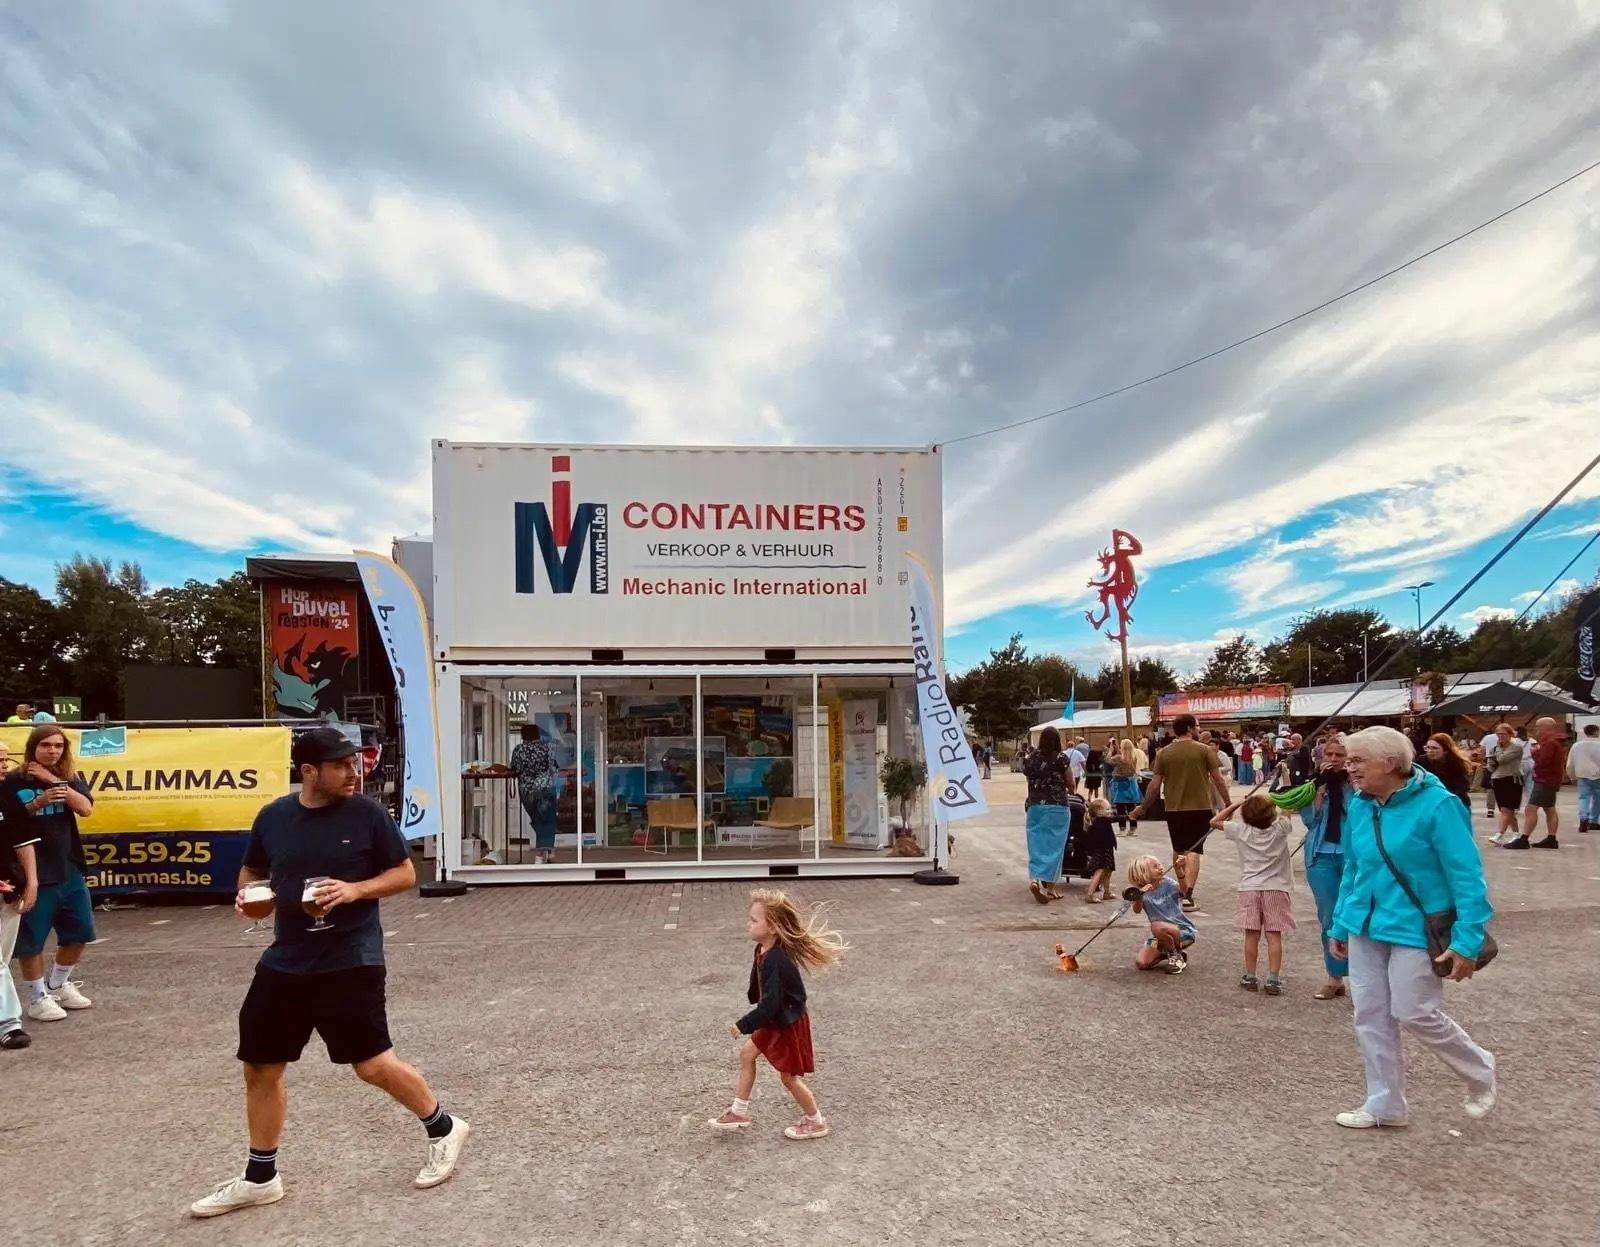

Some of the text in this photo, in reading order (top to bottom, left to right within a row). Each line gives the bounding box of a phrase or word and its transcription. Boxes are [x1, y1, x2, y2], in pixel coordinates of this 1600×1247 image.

[623, 502, 866, 531] CONTAINERS
[592, 506, 606, 591] www.m-i.be
[647, 544, 834, 557] VERKOOP & VERHUUR
[623, 578, 867, 595] Mechanic International
[77, 769, 258, 791] VALIMMAS
[82, 870, 212, 888] alimmas.be
